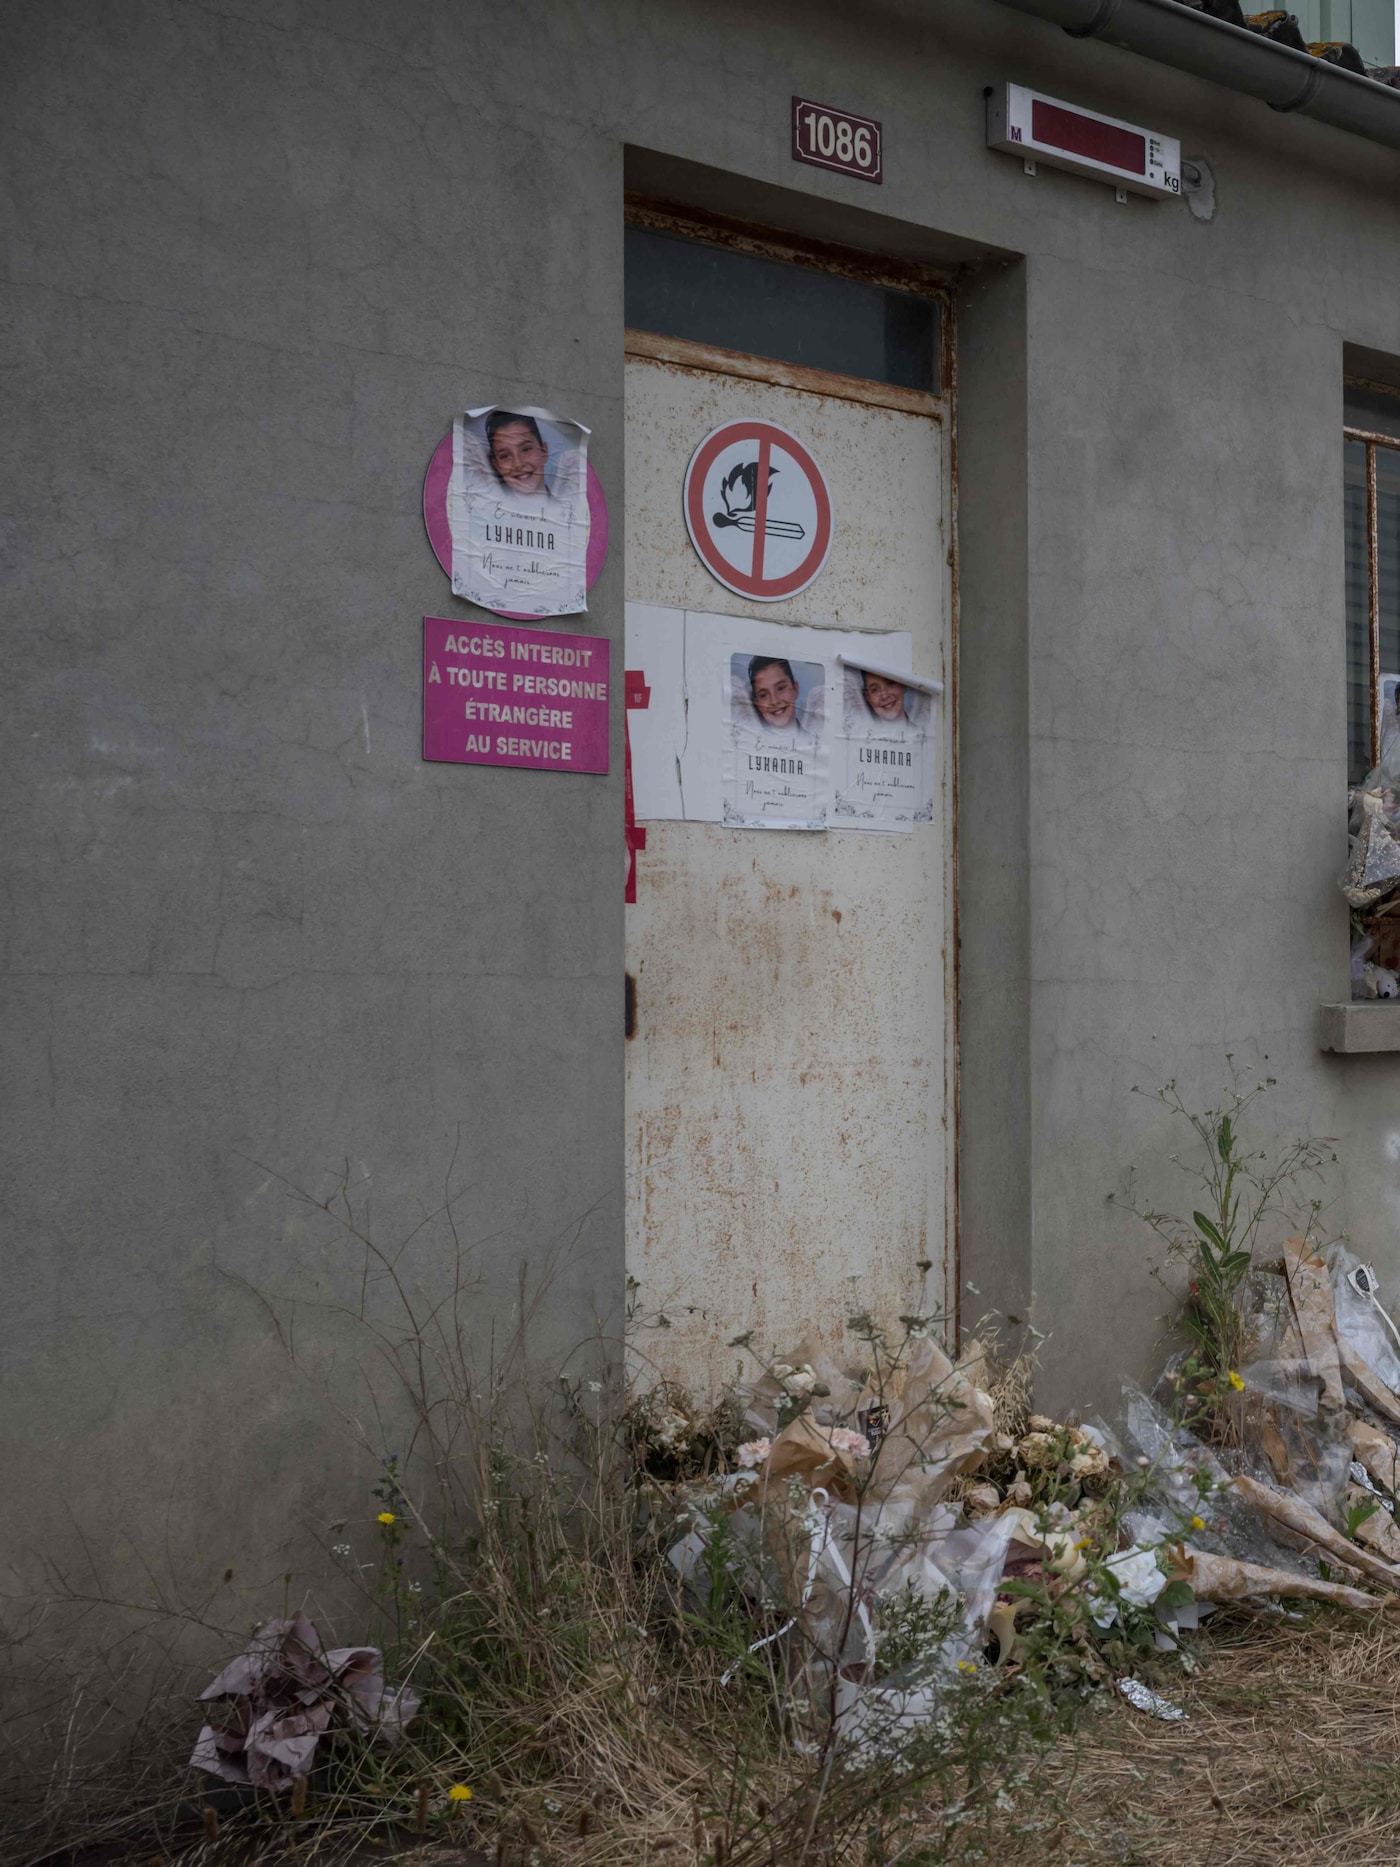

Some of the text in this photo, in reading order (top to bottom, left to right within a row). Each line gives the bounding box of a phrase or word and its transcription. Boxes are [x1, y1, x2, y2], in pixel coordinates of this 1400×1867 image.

[803, 112, 873, 168] 1086
[1009, 124, 1023, 143] M
[1164, 171, 1180, 193] kg
[485, 523, 555, 550] LYHANNA
[482, 551, 503, 575] Nous
[504, 577, 530, 589] jamais
[444, 633, 593, 668] ACCÈS INTERDIT
[428, 660, 442, 684] À
[446, 666, 508, 691] TOUTE
[512, 673, 608, 701] PERSONNE
[465, 697, 573, 729] ÉTRANGÈRE
[465, 734, 572, 761] AU SERVICE
[859, 747, 912, 767] LYHANNA
[748, 755, 804, 776] LYHANNA
